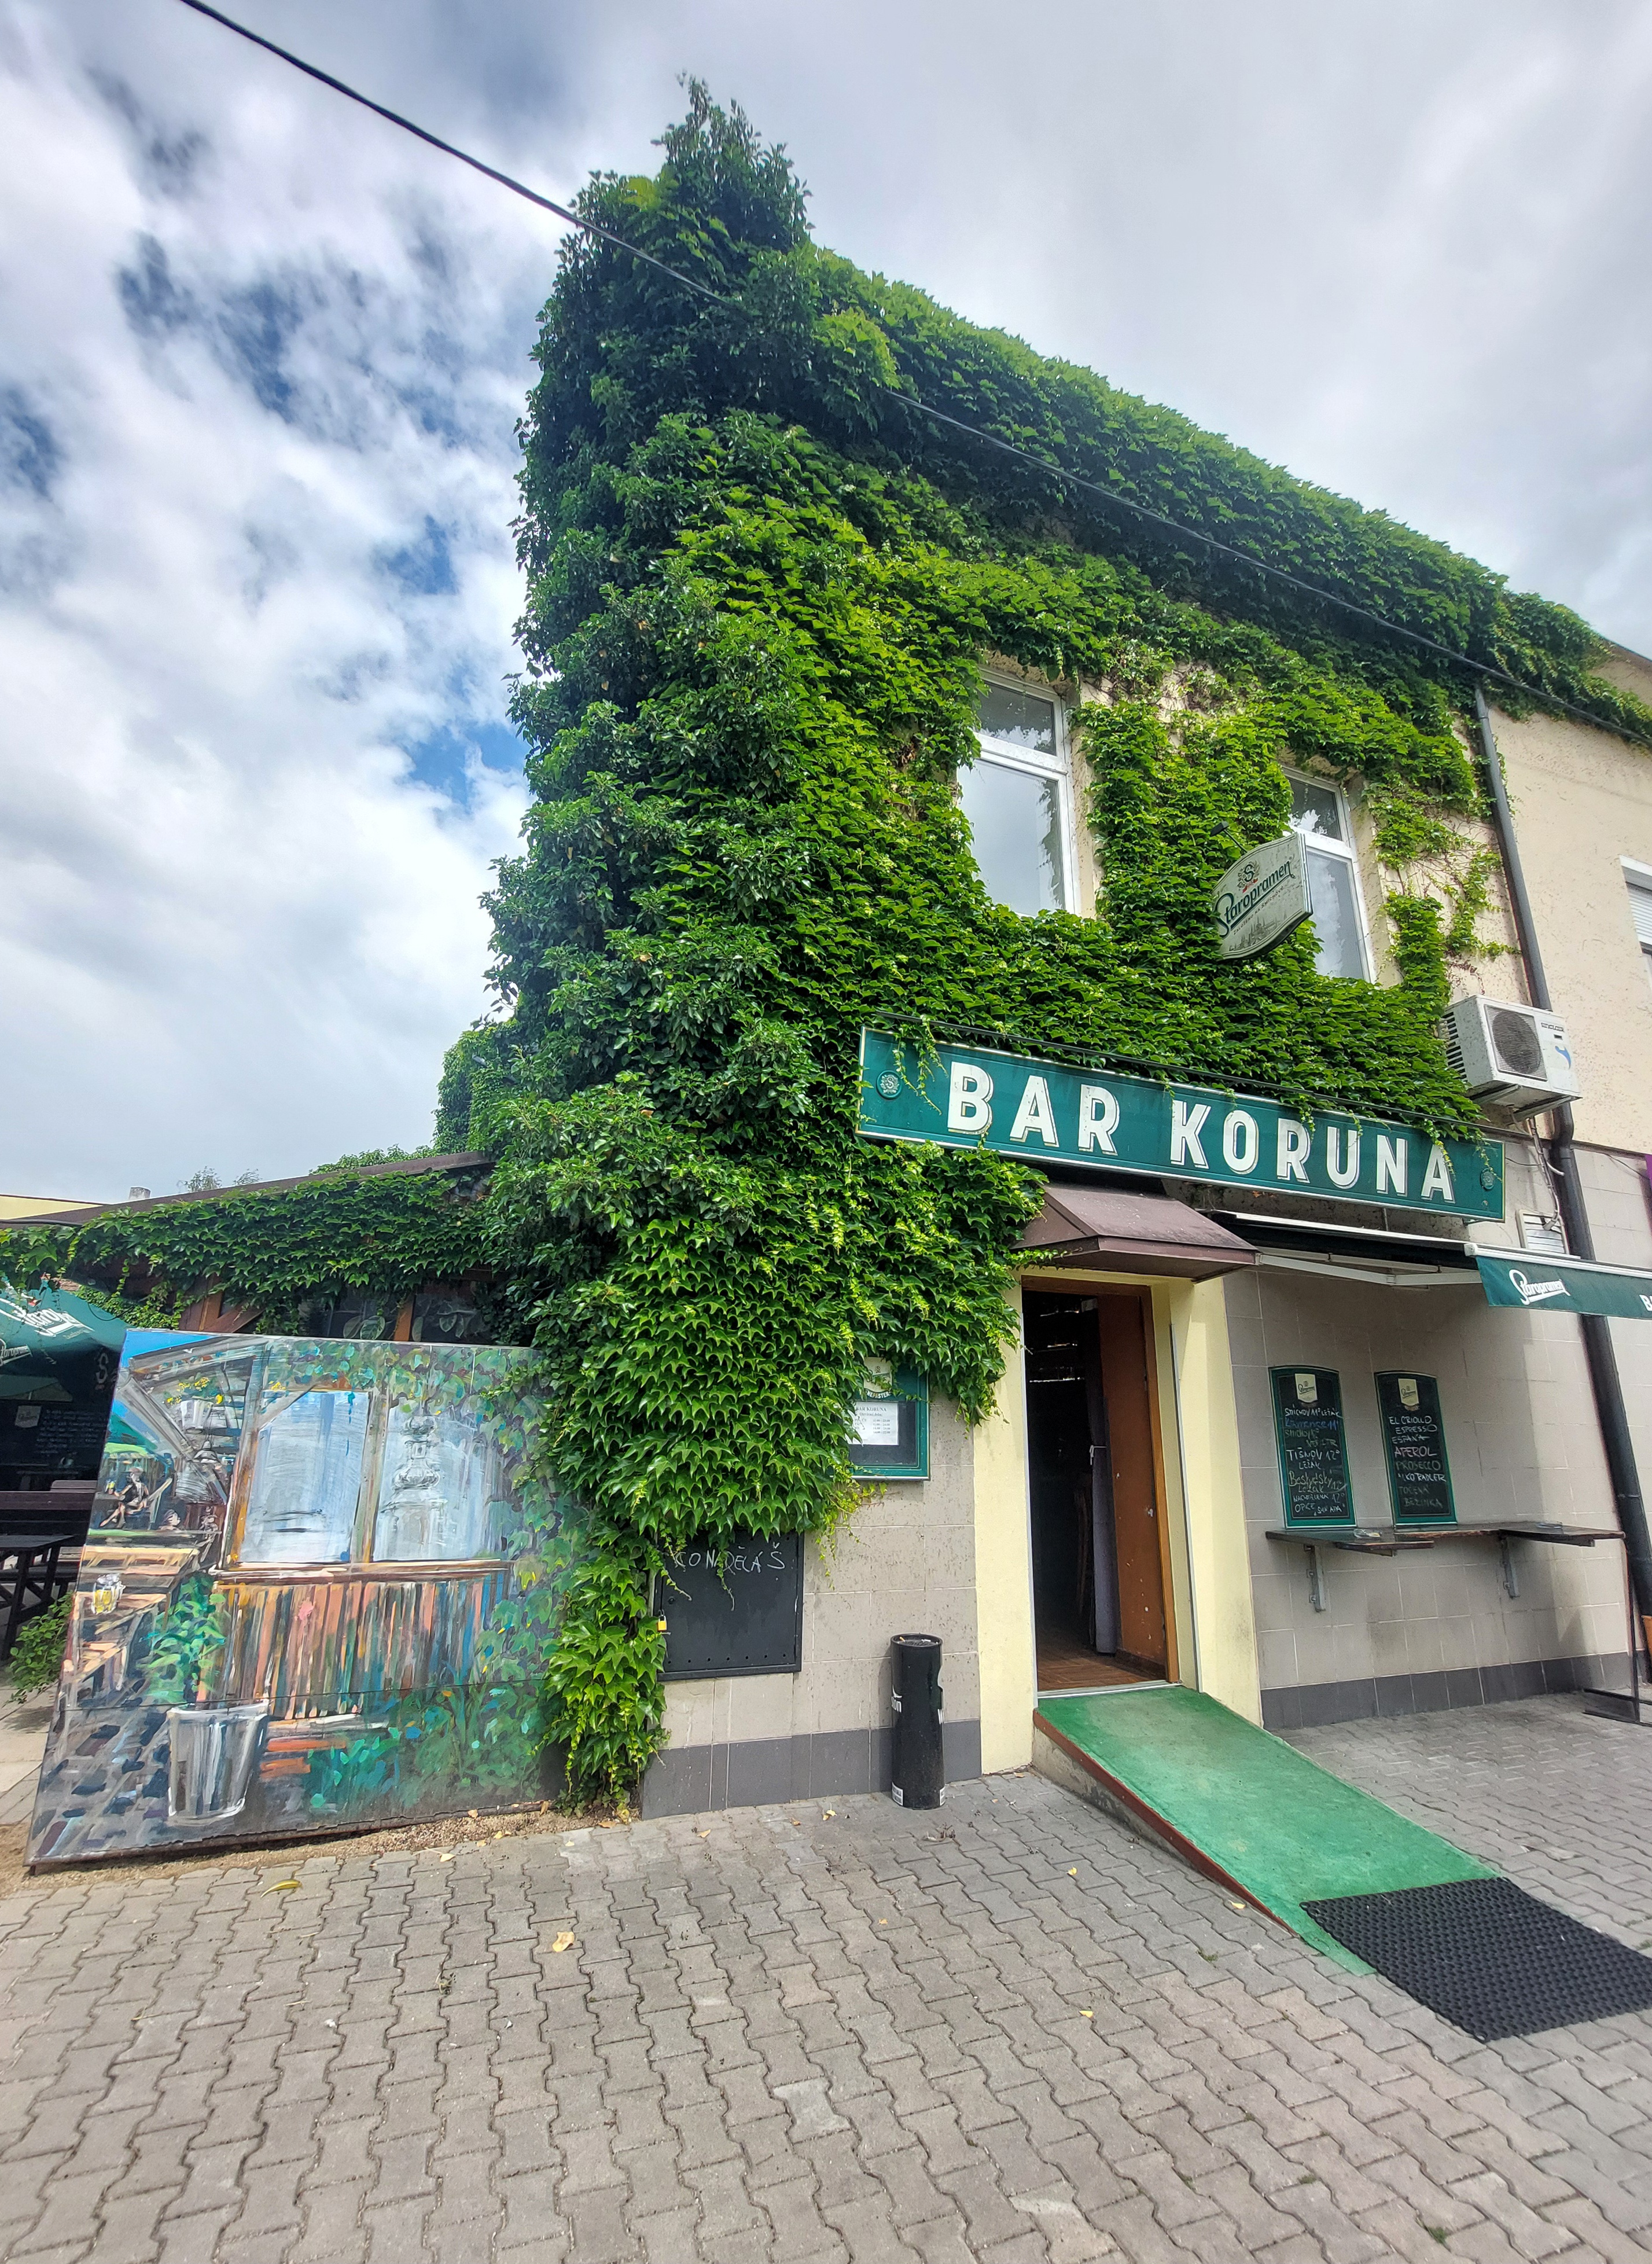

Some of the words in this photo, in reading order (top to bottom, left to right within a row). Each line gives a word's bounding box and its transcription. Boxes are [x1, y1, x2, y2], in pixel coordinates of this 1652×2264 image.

[1214, 860, 1296, 939] Staropramen
[947, 1061, 1118, 1156] BAR
[1169, 1099, 1456, 1204] KORUNA
[1508, 1269, 1571, 1306] Staropramen
[1389, 1416, 1400, 1425] EL
[1401, 1416, 1432, 1424] CRIOLLO
[1395, 1424, 1437, 1435] ESPRESSO
[1285, 1447, 1323, 1461] TIŠNOV
[1395, 1446, 1438, 1458] APEROL
[1396, 1460, 1441, 1471] PROSECCO
[1414, 1472, 1447, 1482] RADLER
[675, 1552, 701, 1568] CO
